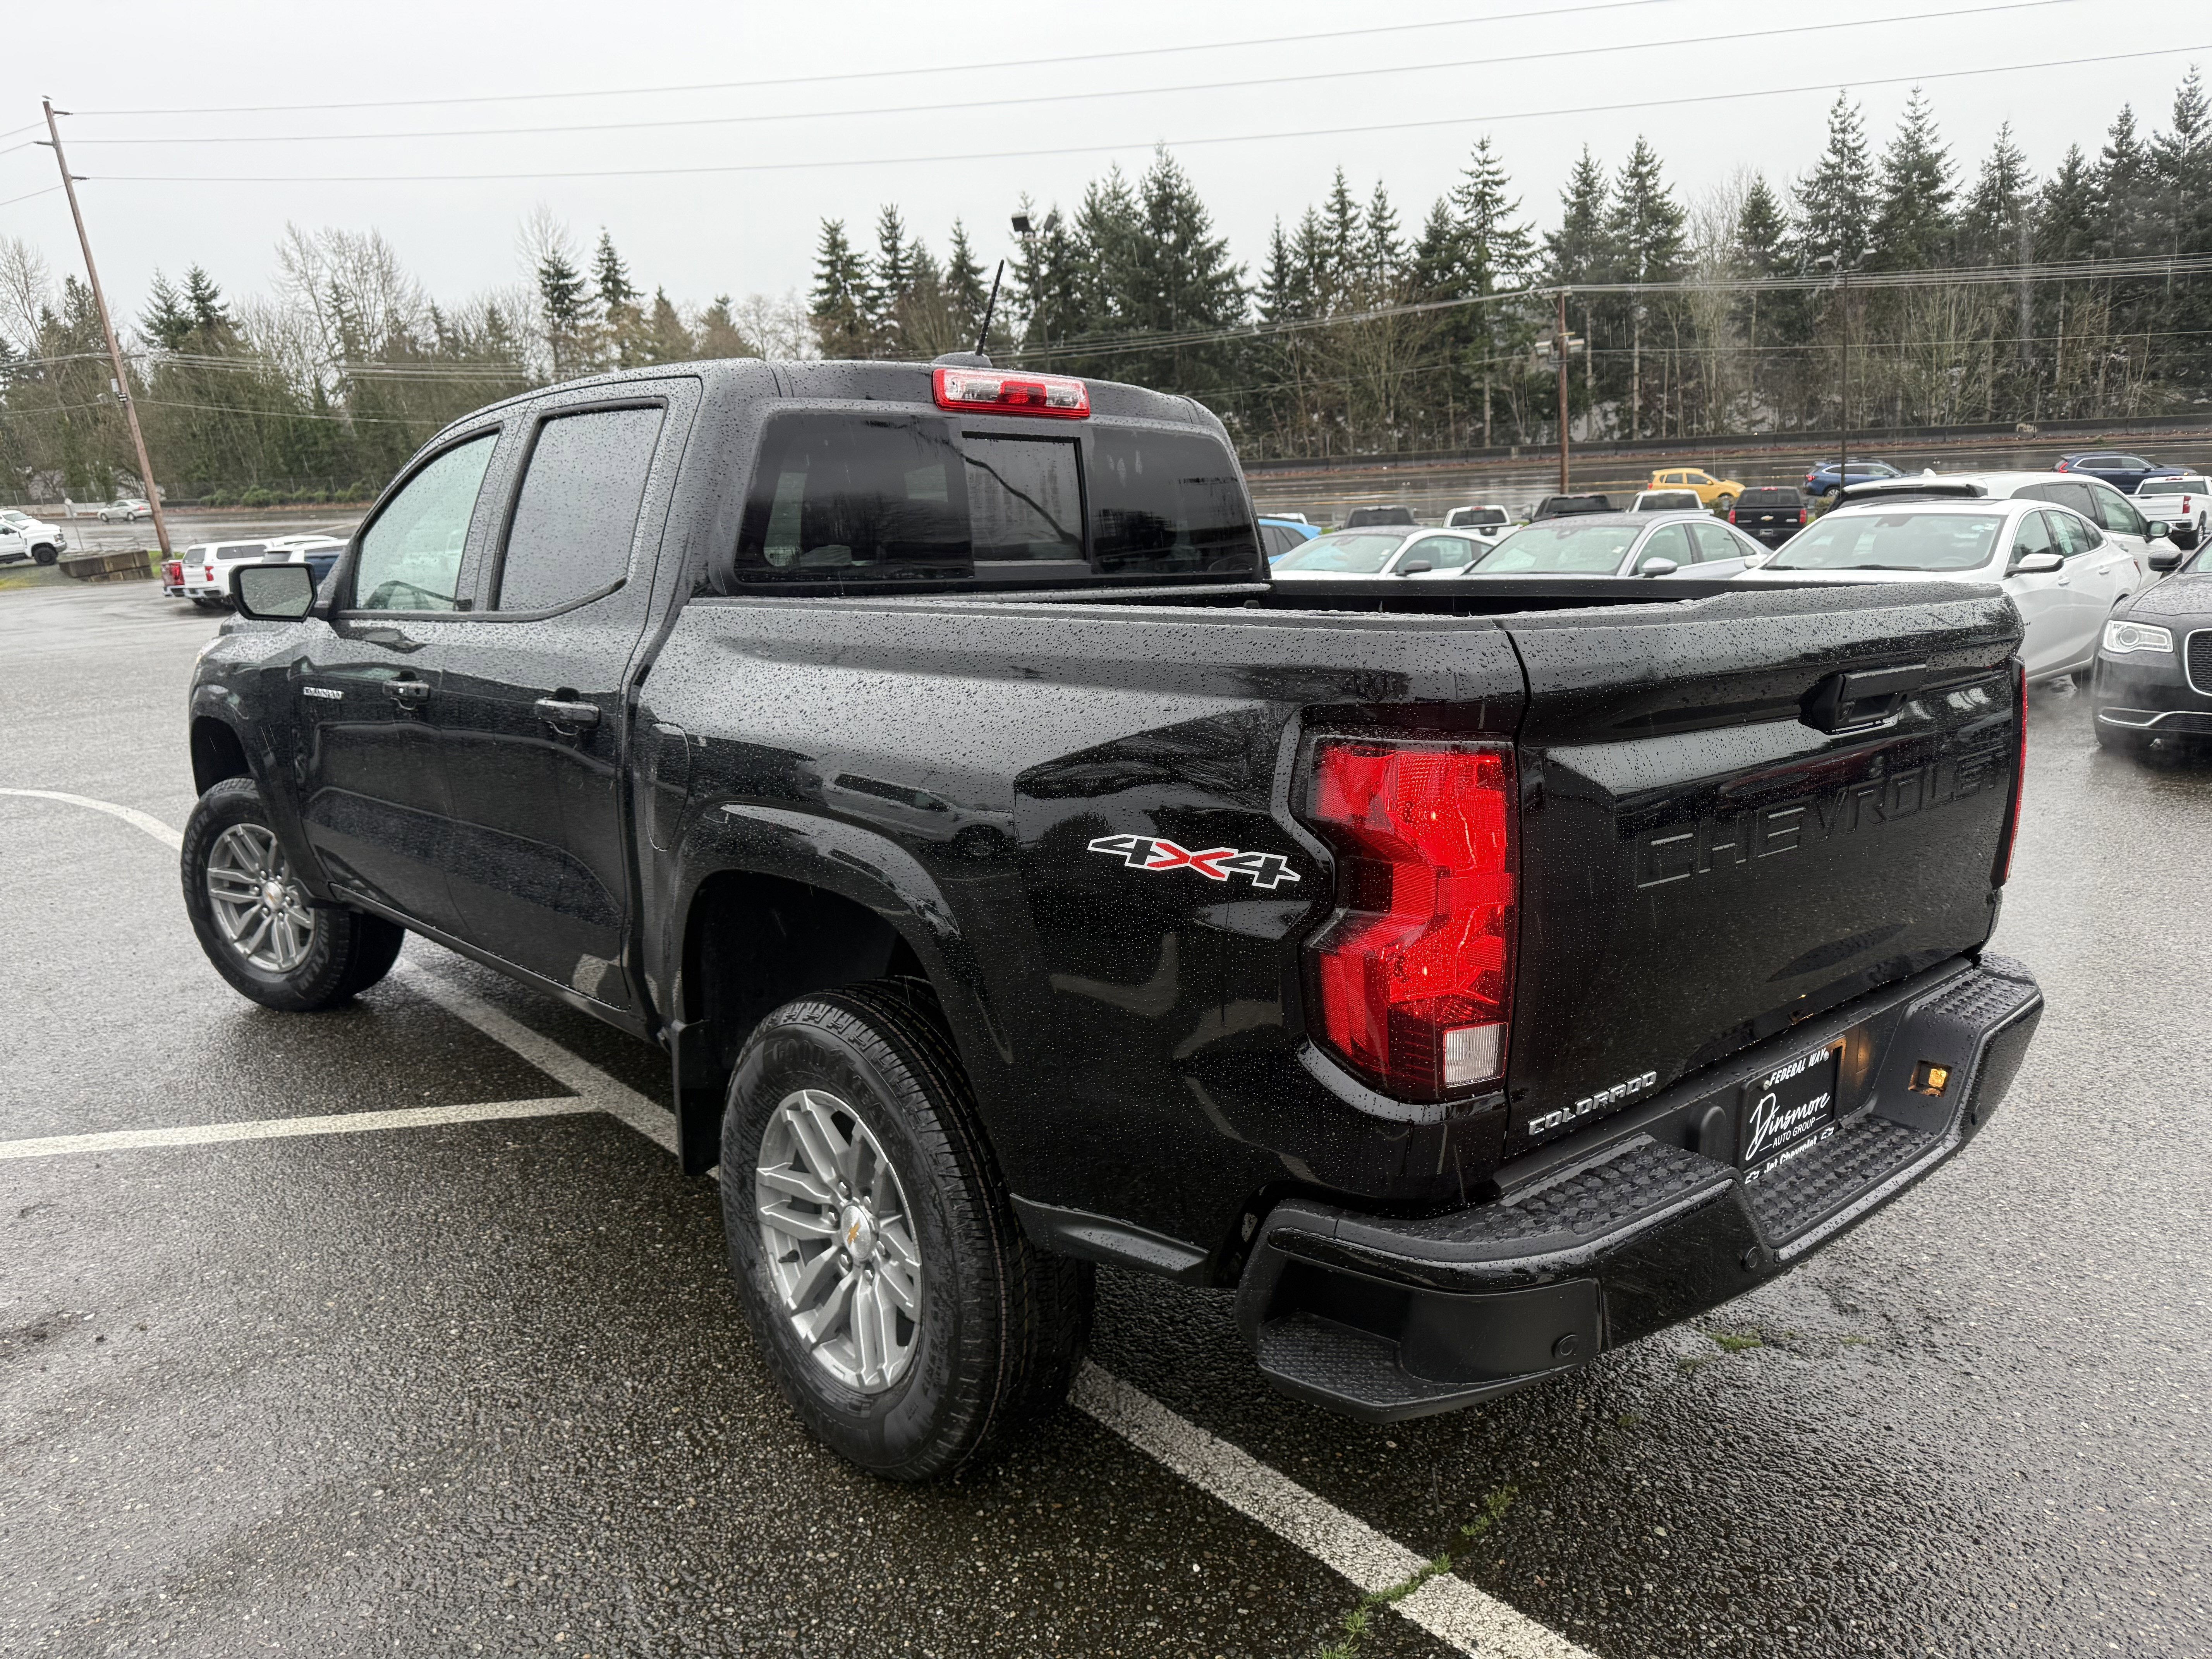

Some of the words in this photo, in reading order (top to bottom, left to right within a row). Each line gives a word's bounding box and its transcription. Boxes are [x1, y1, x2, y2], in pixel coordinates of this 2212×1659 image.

[1635, 744, 2007, 889] CHEVROLET
[1769, 1058, 1806, 1086] FEDERAL
[1808, 1047, 1826, 1067] WAY
[1528, 1070, 1657, 1135] COLORADO
[1745, 1092, 1830, 1161] Dinsmore
[1772, 1130, 1791, 1148] AUTO
[1793, 1117, 1816, 1137] GROUP
